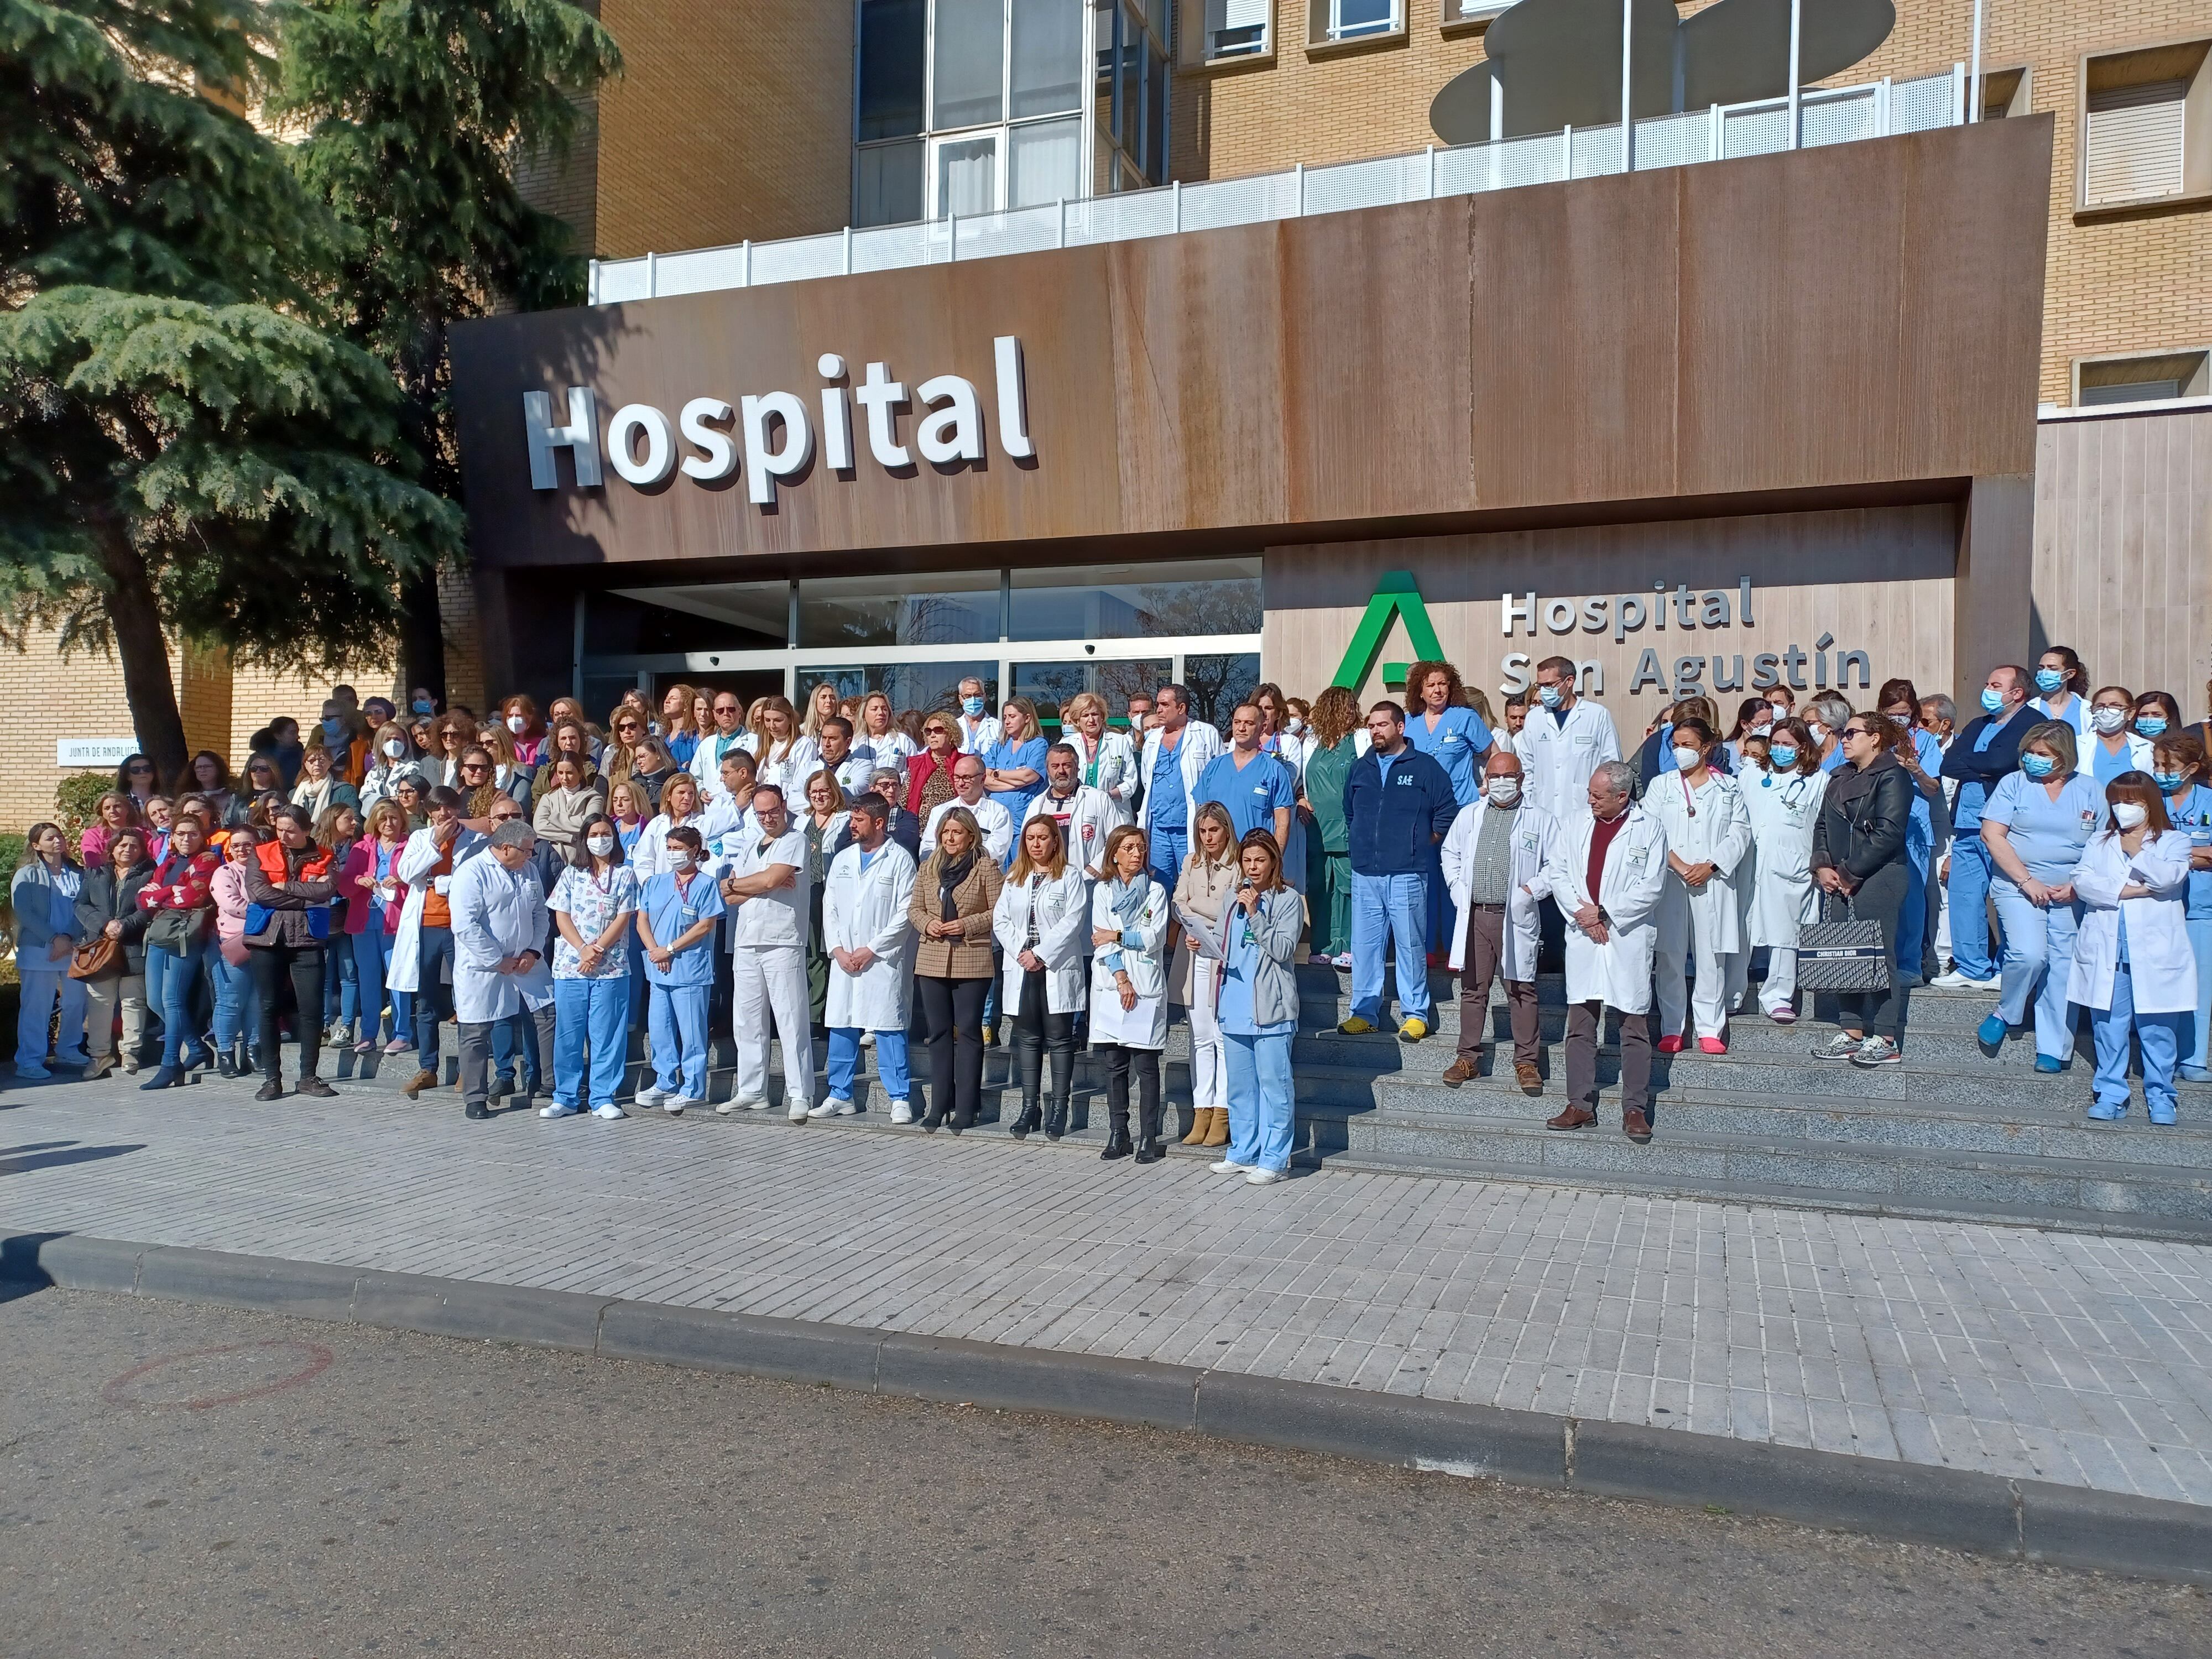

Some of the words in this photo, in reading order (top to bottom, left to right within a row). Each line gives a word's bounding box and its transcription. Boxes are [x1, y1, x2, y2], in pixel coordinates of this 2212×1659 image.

[523, 335, 1035, 503] Hospital
[1502, 576, 1752, 640] Hospital
[1499, 652, 1603, 695] Sn
[1630, 632, 1870, 702] Agustín
[69, 747, 90, 757] JUNTA
[92, 747, 100, 757] DE
[103, 747, 139, 757] ANDALUCI
[1397, 775, 1413, 786] SAE
